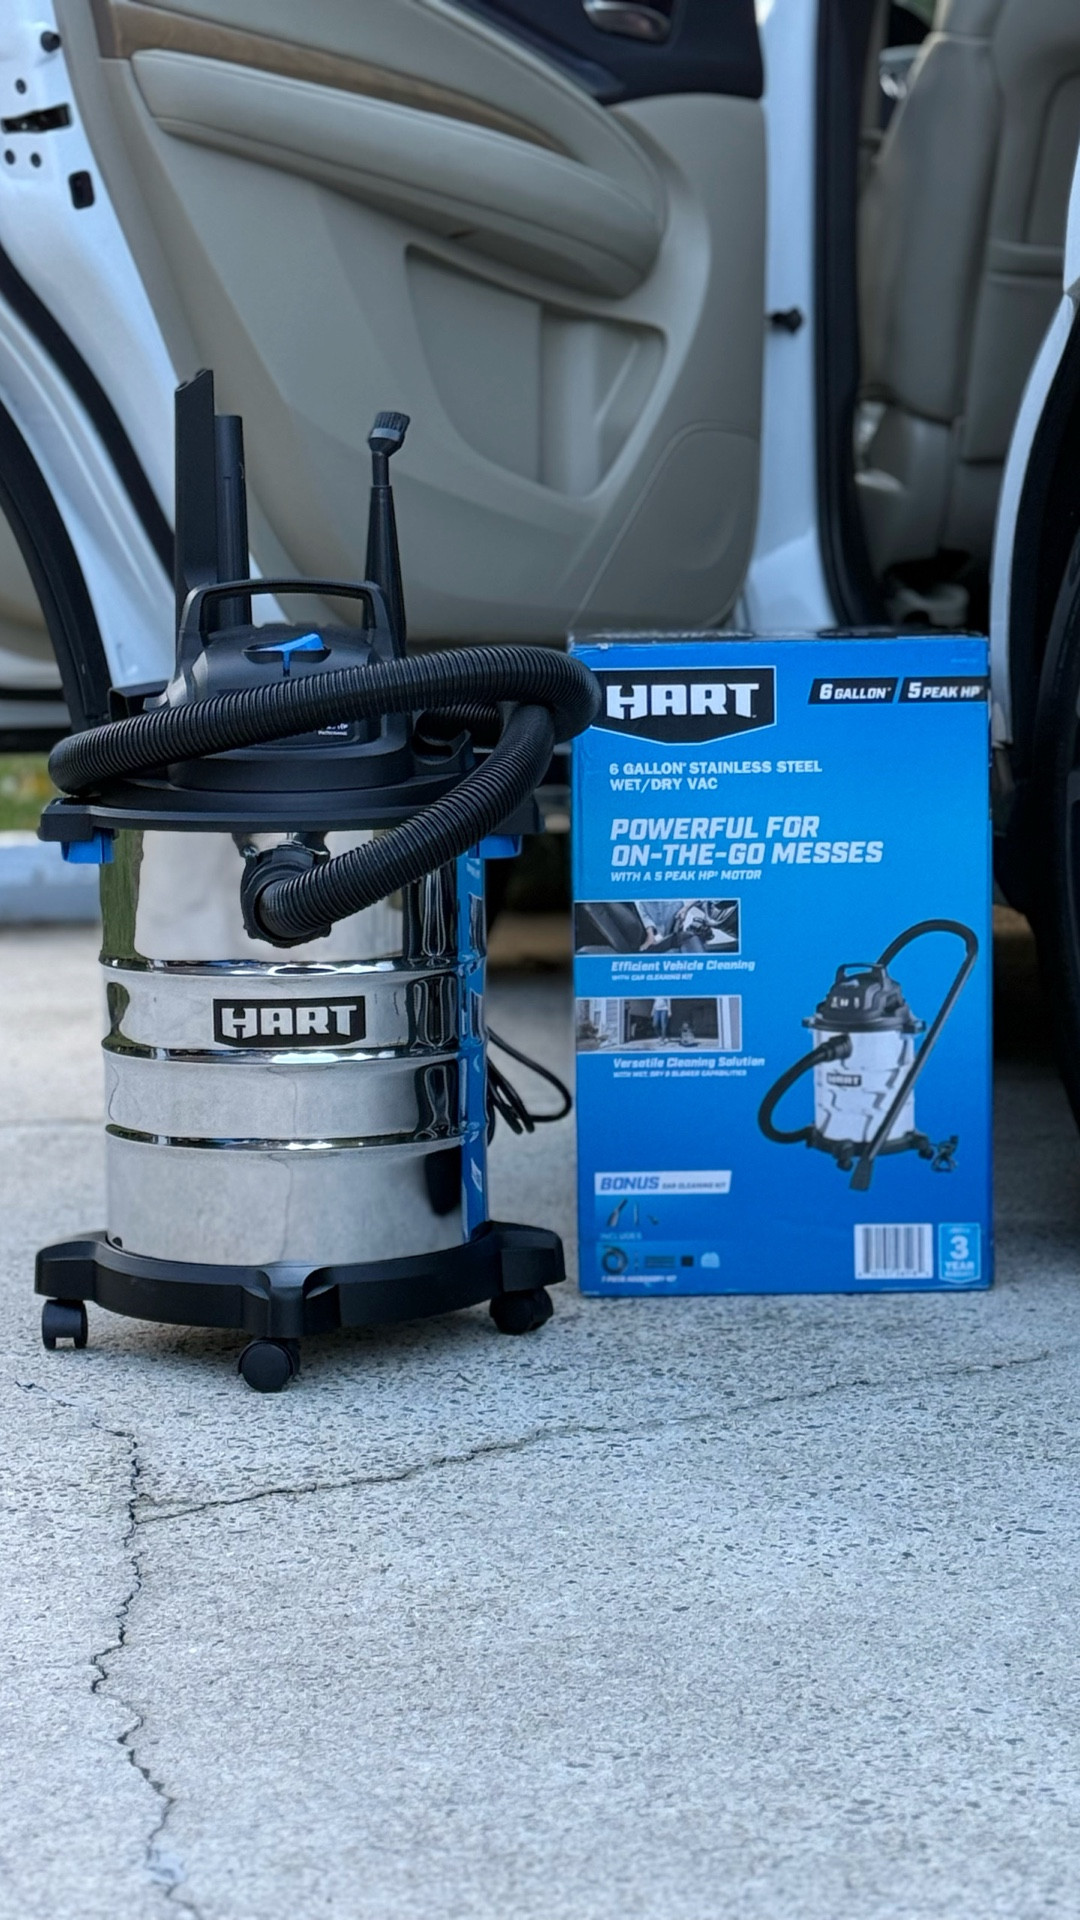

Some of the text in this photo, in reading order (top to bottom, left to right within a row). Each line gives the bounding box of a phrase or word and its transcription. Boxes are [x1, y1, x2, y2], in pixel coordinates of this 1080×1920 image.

[819, 683, 833, 700] 6
[908, 682, 922, 699] 5
[922, 686, 959, 699] PEAK
[606, 683, 759, 720] HART
[609, 763, 619, 775] 6
[689, 761, 772, 775] STAINLESS
[776, 760, 822, 773] STEEL
[610, 777, 718, 793] WET/DRY VAC
[610, 815, 820, 841] POWERFUL FOR
[611, 841, 884, 867] ON-THE-GO MESSES
[611, 871, 641, 882] WITH
[643, 871, 652, 881] A
[654, 871, 663, 881] 5
[664, 870, 696, 881] PEAK
[721, 869, 762, 880] MOTOR
[611, 959, 755, 972] Efficient Vehicle Cleaning
[221, 1005, 357, 1039] HART
[613, 1056, 765, 1069] Versatile Cleaning Solution
[600, 1176, 660, 1191] BONUS
[949, 1235, 969, 1260] 3
[944, 1261, 975, 1271] YEAR
